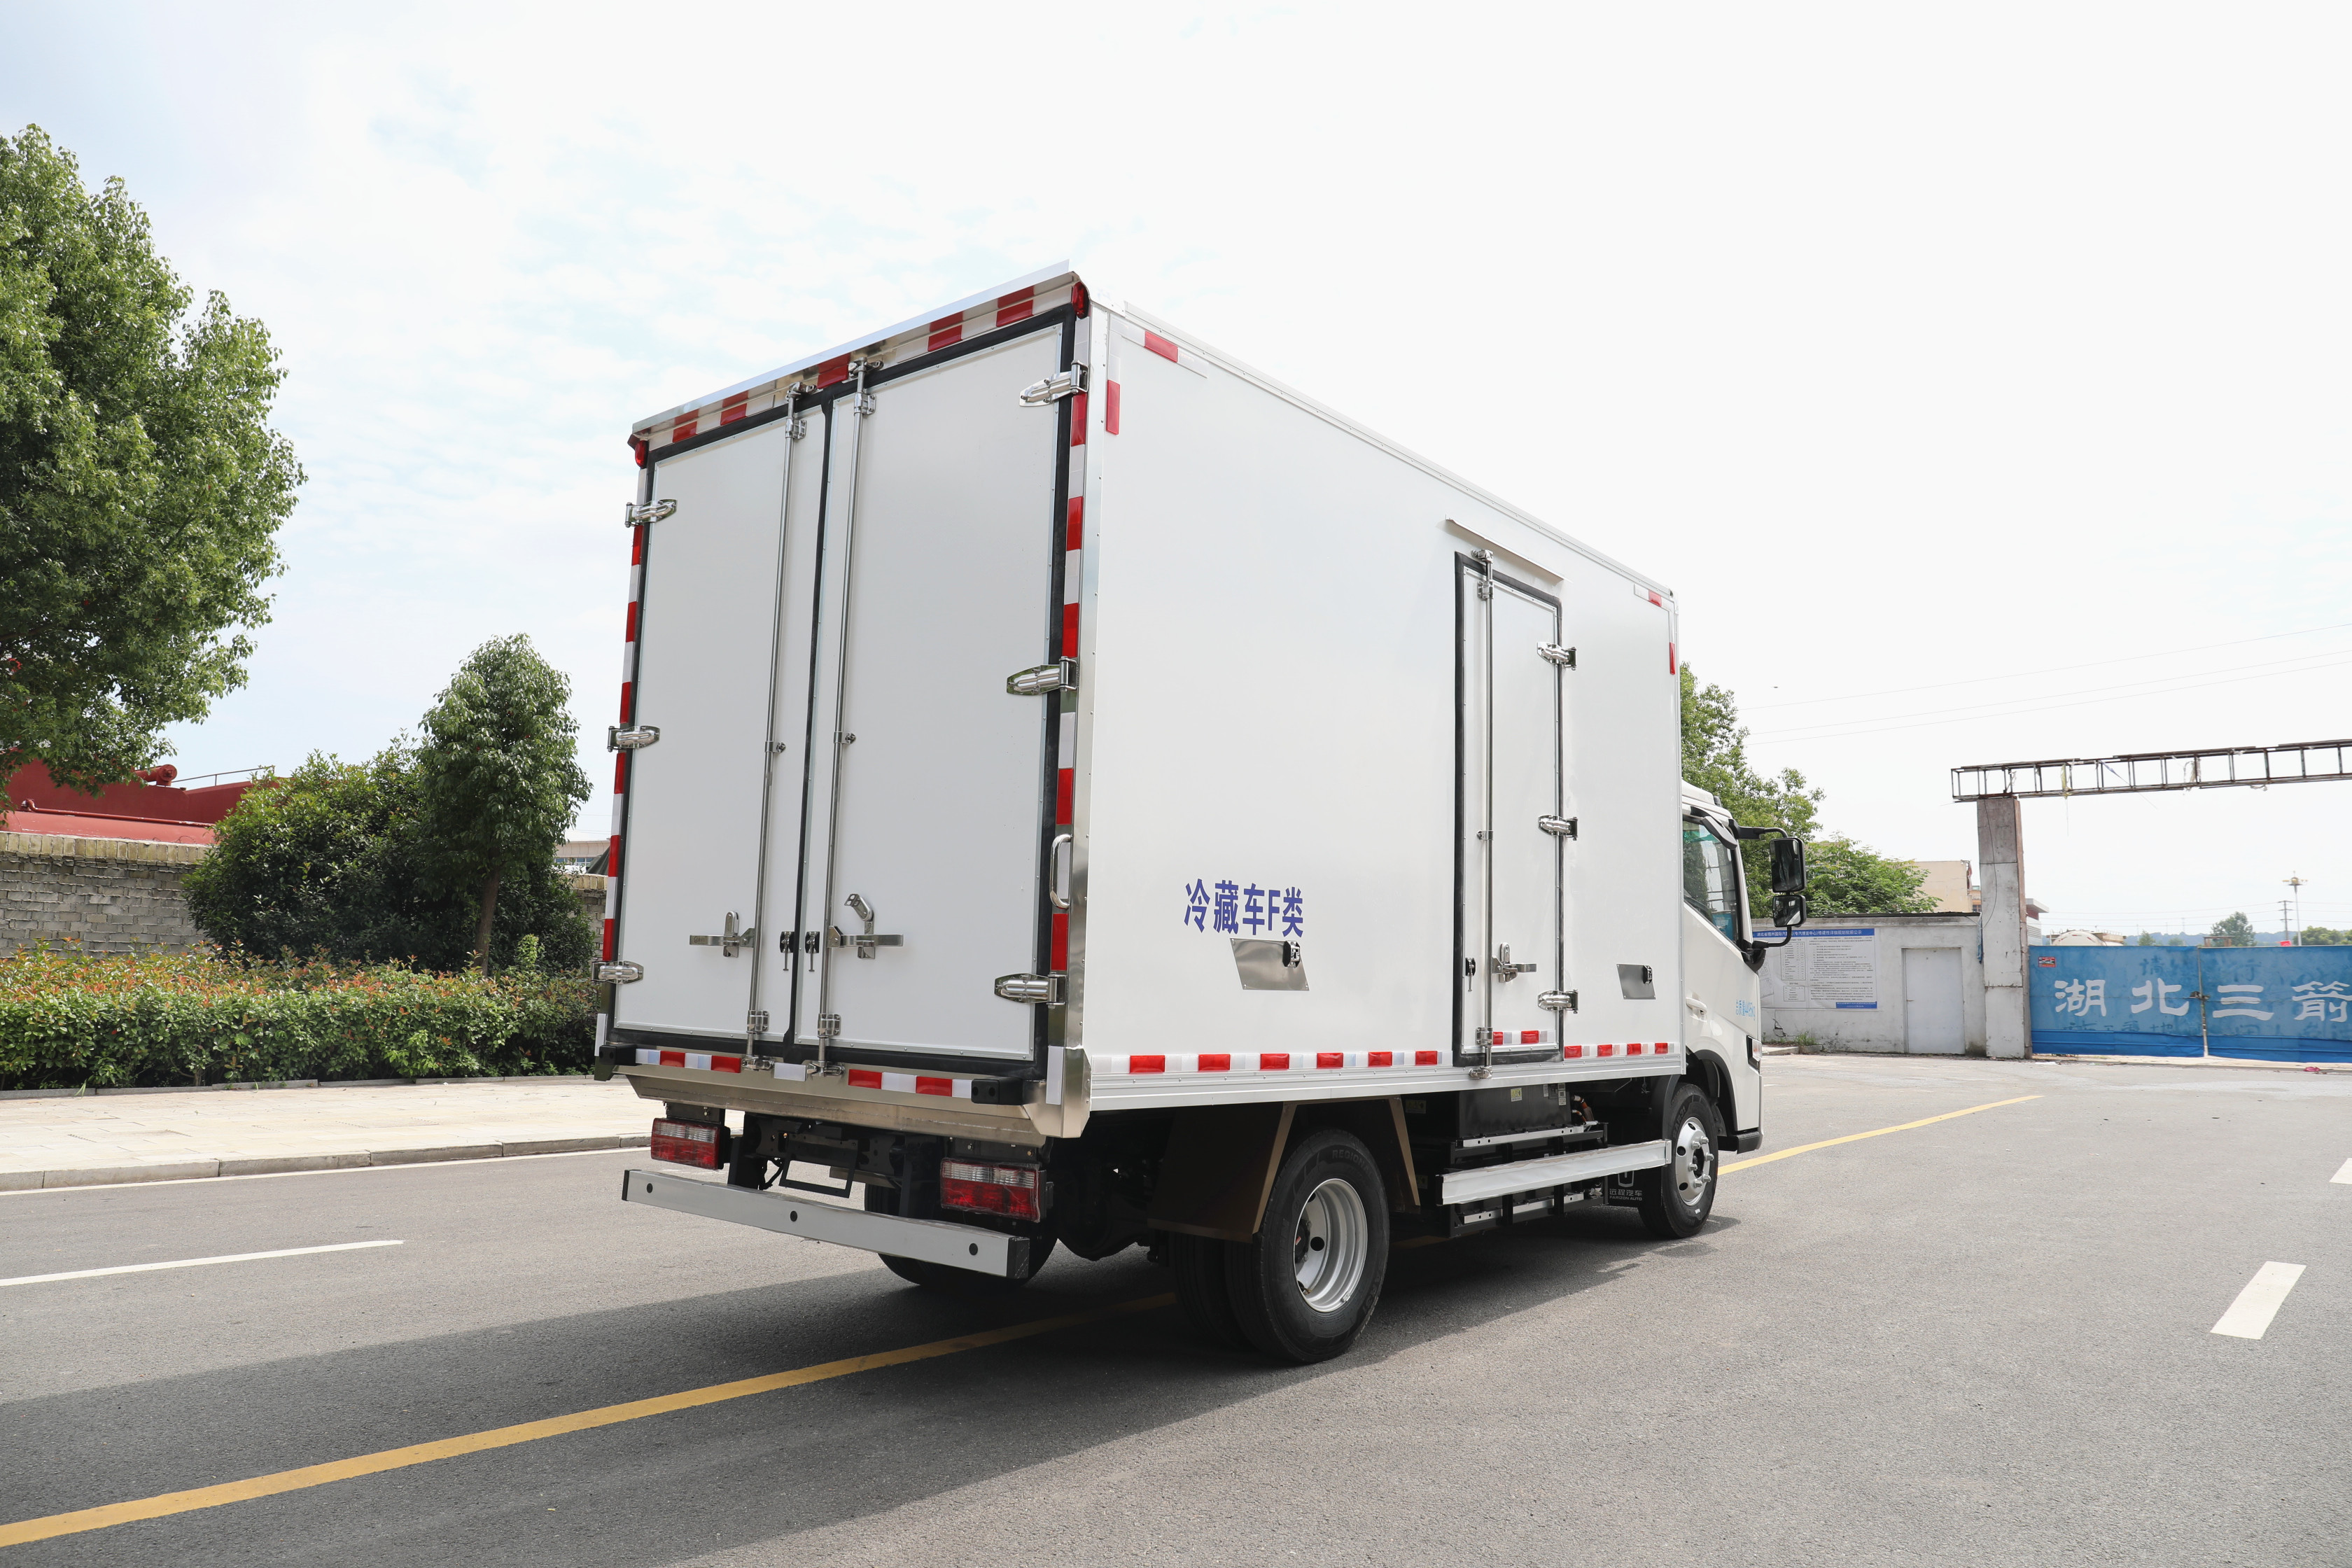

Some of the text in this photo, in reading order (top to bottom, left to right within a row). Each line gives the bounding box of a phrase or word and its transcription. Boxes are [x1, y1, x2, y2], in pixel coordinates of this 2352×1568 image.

[1184, 878, 1303, 938] 冷藏车F类
[2054, 977, 2352, 1023] 湖北三箭
[1609, 1188, 1643, 1197] 远程汽车
